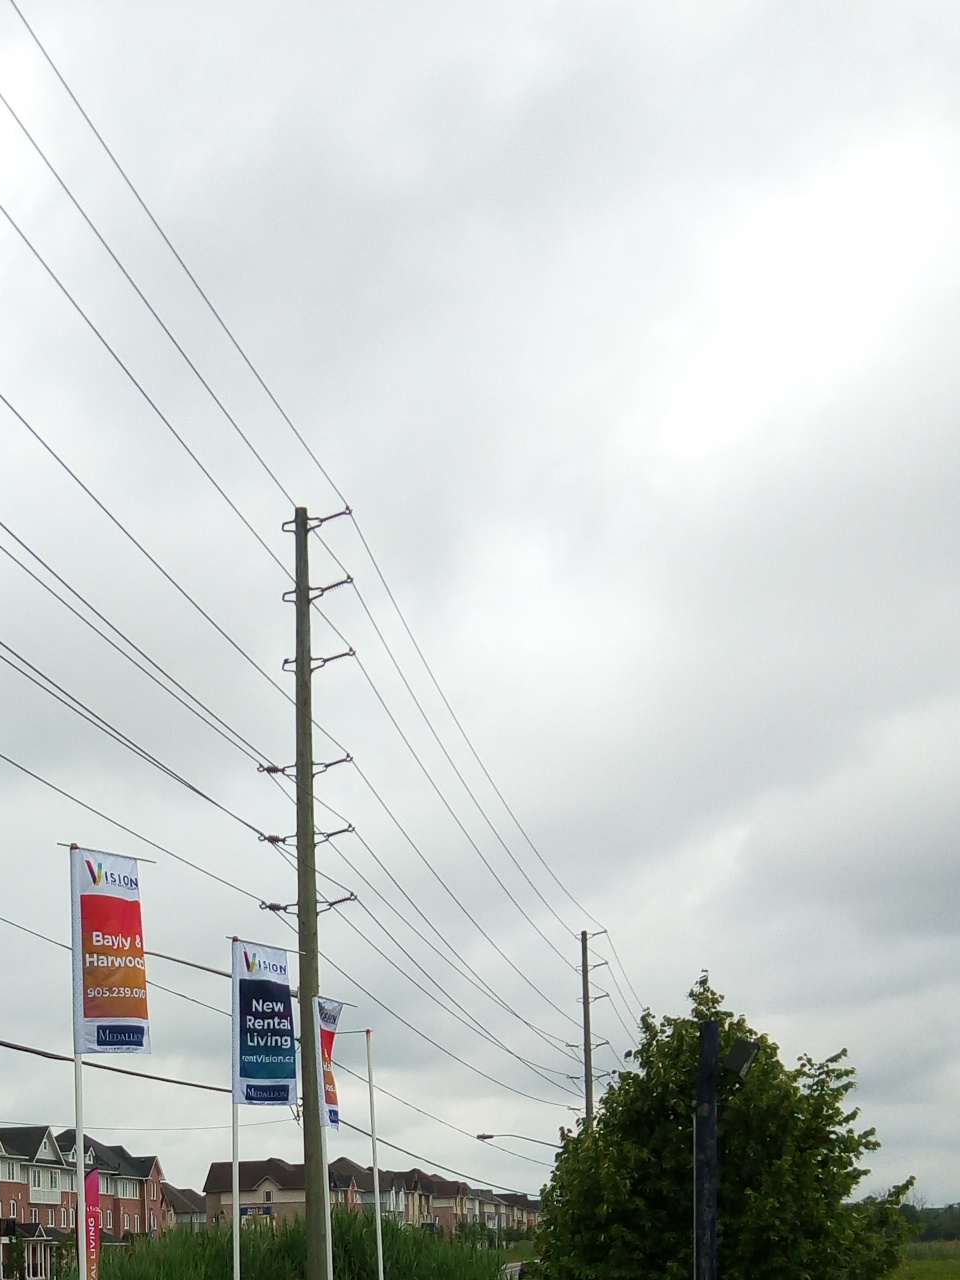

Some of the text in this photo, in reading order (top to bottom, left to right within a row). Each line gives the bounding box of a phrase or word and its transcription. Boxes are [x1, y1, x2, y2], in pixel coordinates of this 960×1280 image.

[85, 859, 138, 888] VISION
[92, 931, 131, 950] Bayly
[252, 998, 284, 1012] New
[246, 1015, 291, 1030] Rental
[247, 1032, 291, 1049] Living
[88, 1217, 96, 1259] LIVING
